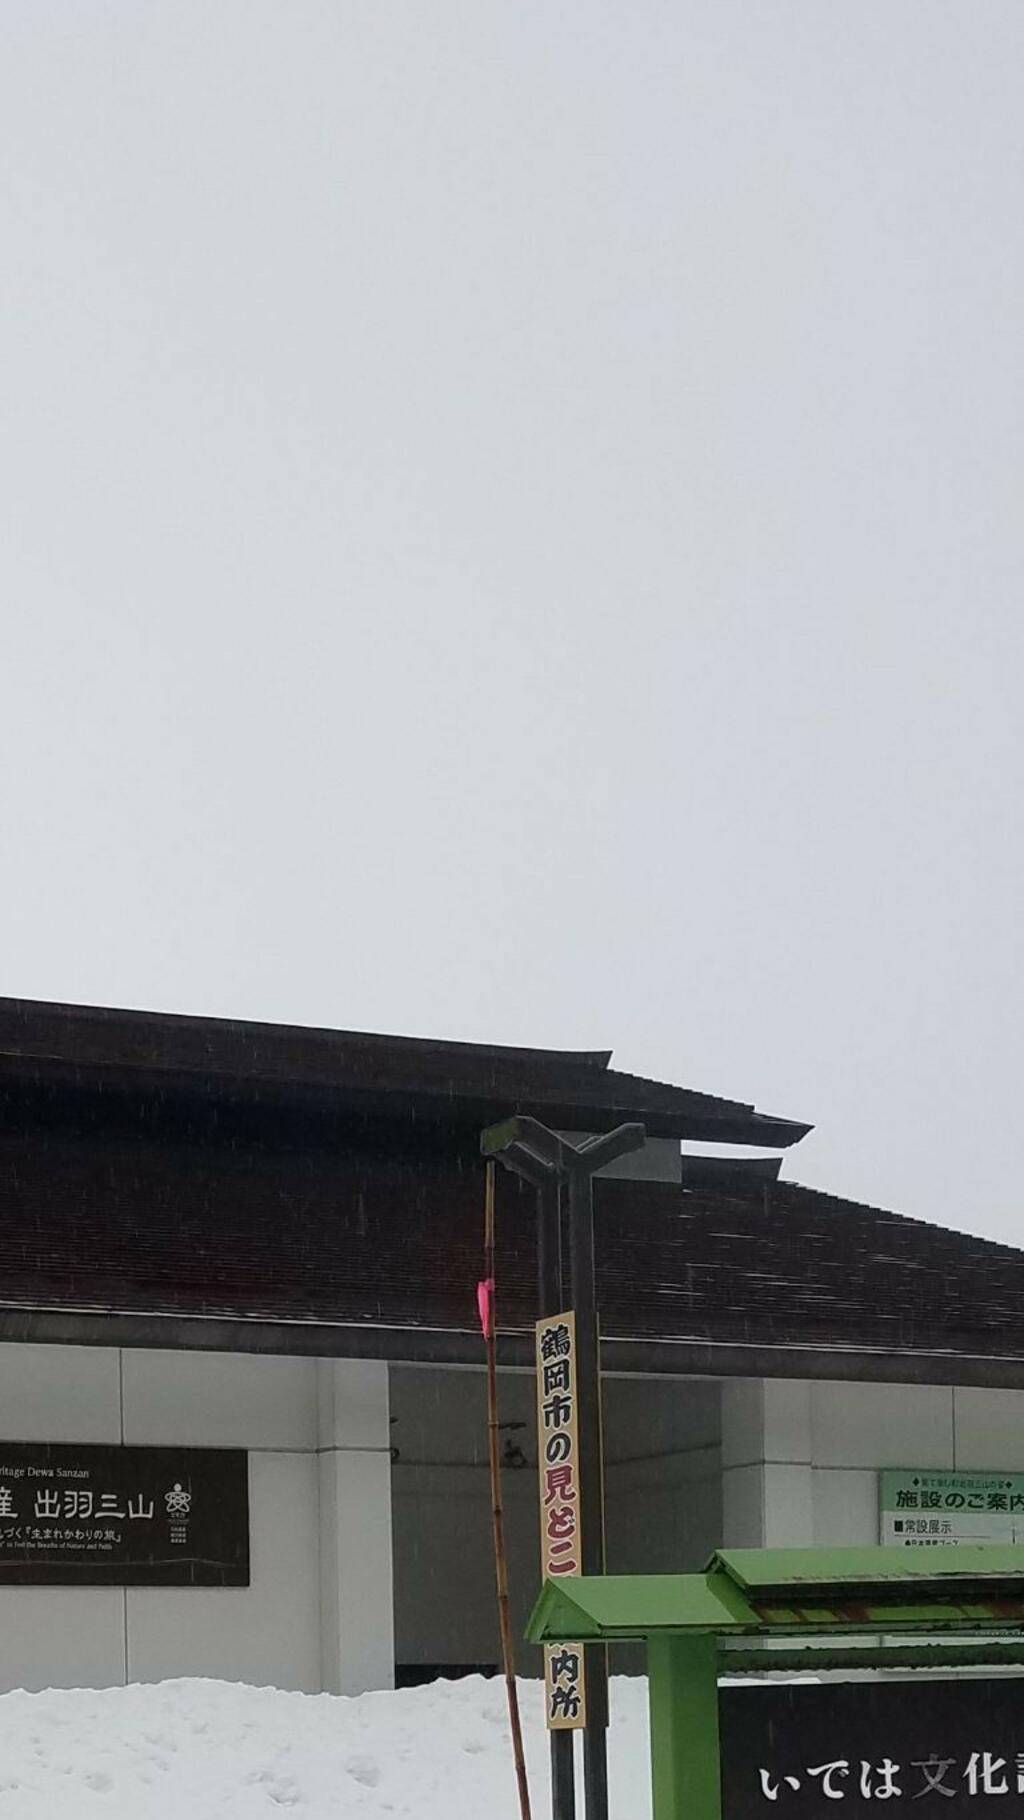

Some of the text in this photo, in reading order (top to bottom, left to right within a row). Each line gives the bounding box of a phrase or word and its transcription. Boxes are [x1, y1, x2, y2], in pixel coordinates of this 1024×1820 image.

[28, 1467, 54, 1477] Dewa
[57, 1468, 89, 1478] Sanzan
[34, 1489, 154, 1519] 出羽三山
[896, 1490, 1024, 1511] 施設のご案内
[541, 1324, 581, 1718] 鶴岡市の見どこ内所
[905, 1520, 952, 1534] 常設展示
[759, 1752, 1024, 1800] いでは文化
